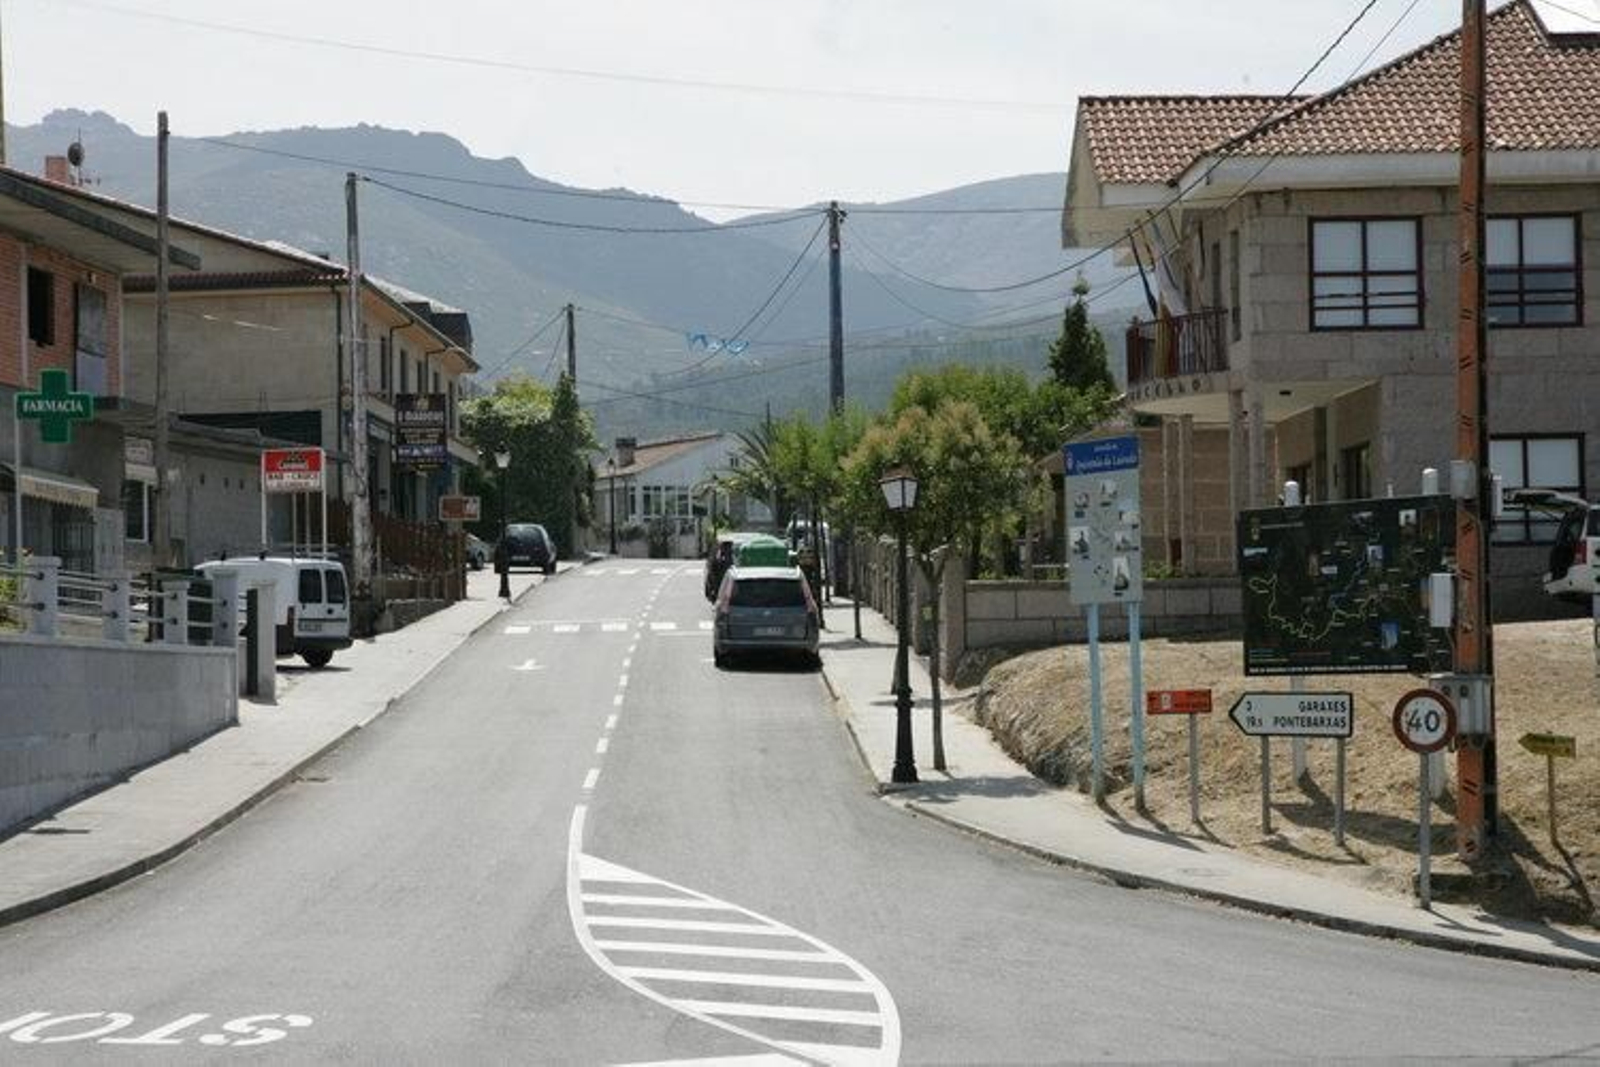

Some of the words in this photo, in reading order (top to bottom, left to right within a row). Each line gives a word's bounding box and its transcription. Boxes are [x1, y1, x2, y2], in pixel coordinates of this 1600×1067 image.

[22, 399, 83, 412] FARMACIA
[1299, 701, 1346, 712] GARAXES
[1273, 716, 1346, 728] PONTEBARXAS
[1409, 709, 1440, 733] 40
